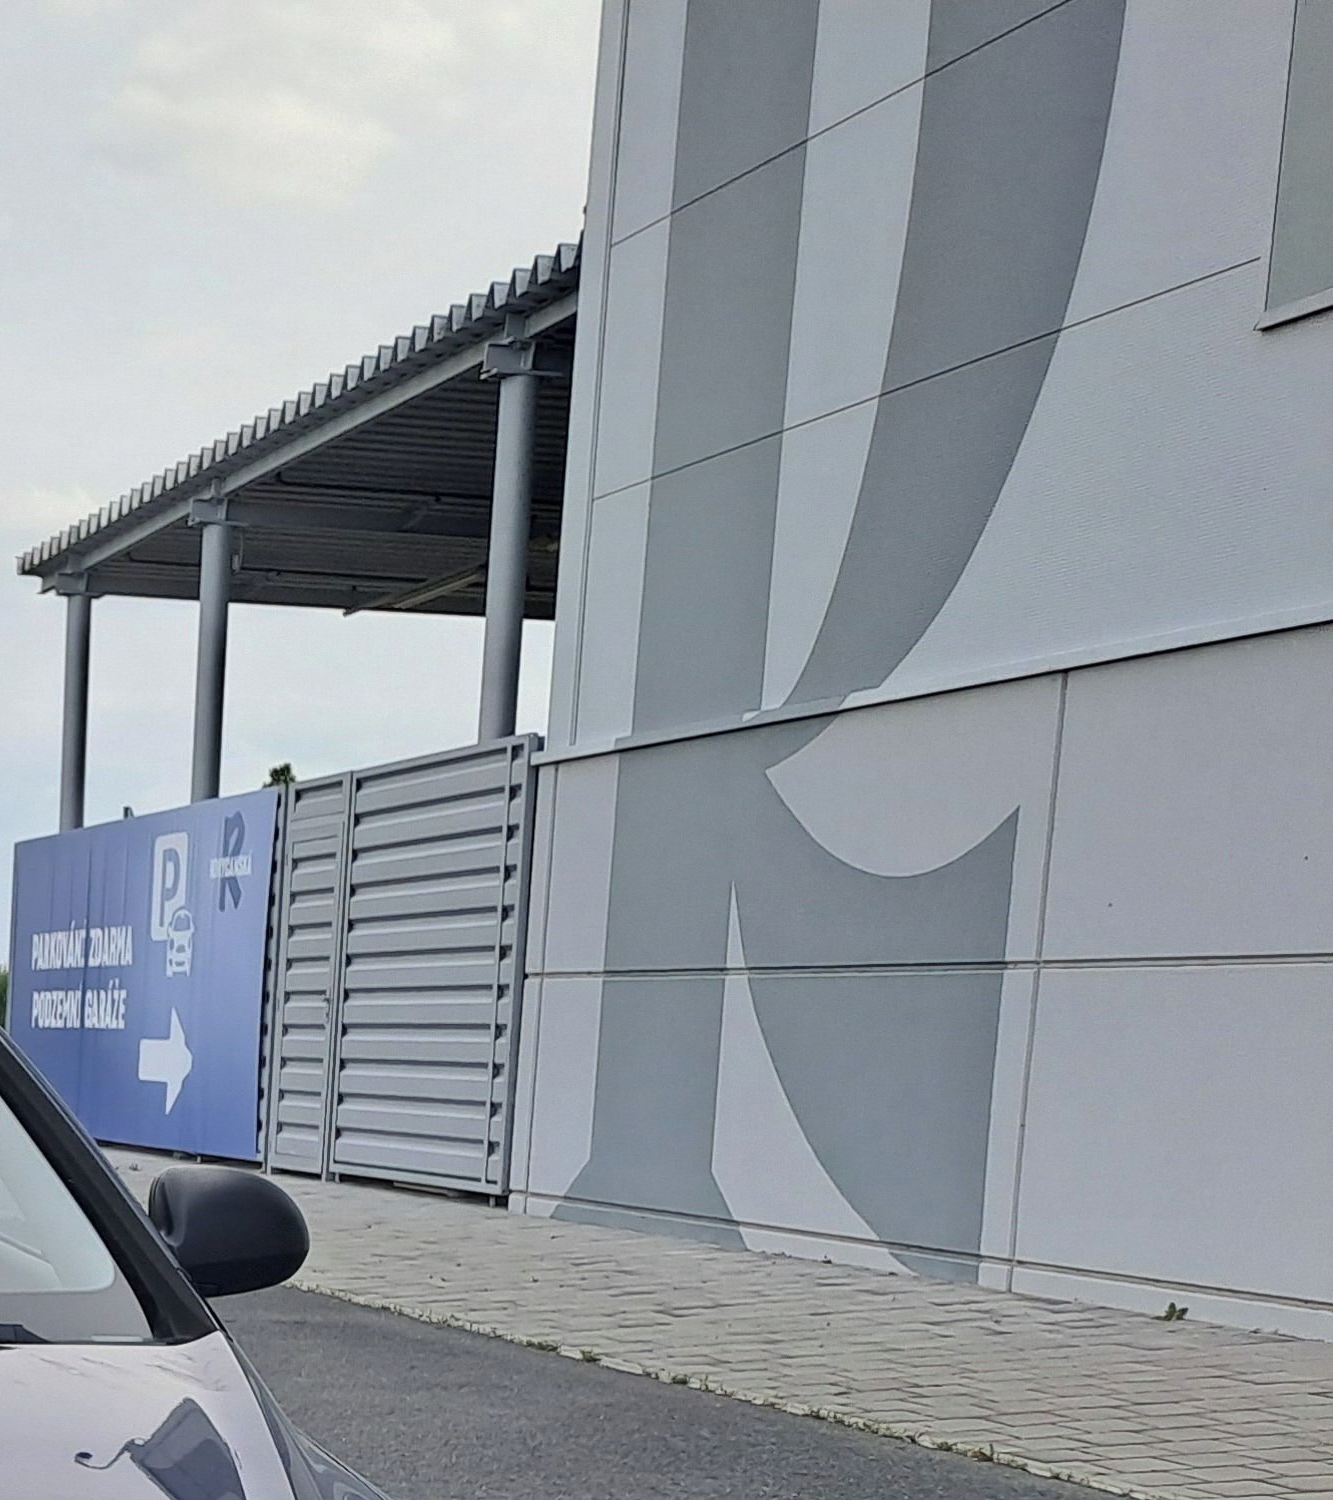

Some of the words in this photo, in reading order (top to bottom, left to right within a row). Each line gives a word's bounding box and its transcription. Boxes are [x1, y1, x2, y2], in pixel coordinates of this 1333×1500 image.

[31, 919, 87, 971] PARKOVÁNÍ
[88, 925, 132, 968] ZDARMA
[31, 980, 83, 1029] PODZEMNÍ
[84, 978, 127, 1030] GARÁŽE
